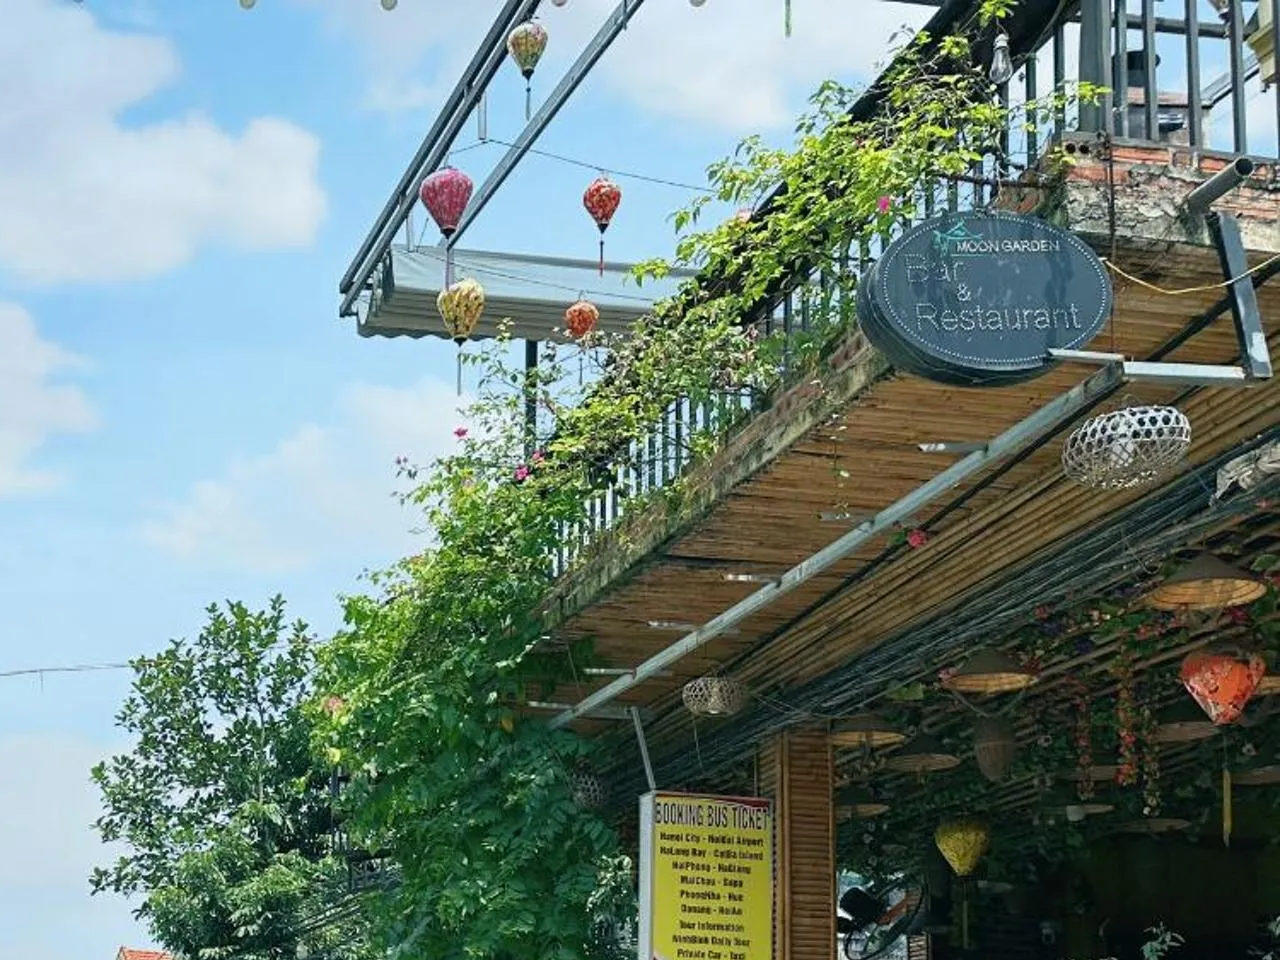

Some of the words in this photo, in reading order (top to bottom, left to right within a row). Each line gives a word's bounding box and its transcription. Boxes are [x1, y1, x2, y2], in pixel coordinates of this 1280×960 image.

[956, 240, 999, 252] MOON
[1001, 240, 1060, 252] GARDEN
[904, 253, 965, 282] Bar
[956, 283, 971, 301] &
[915, 303, 1082, 330] Restaurant
[656, 802, 704, 827] BOOKING
[707, 805, 728, 828] BUS
[731, 806, 768, 830] TICKET
